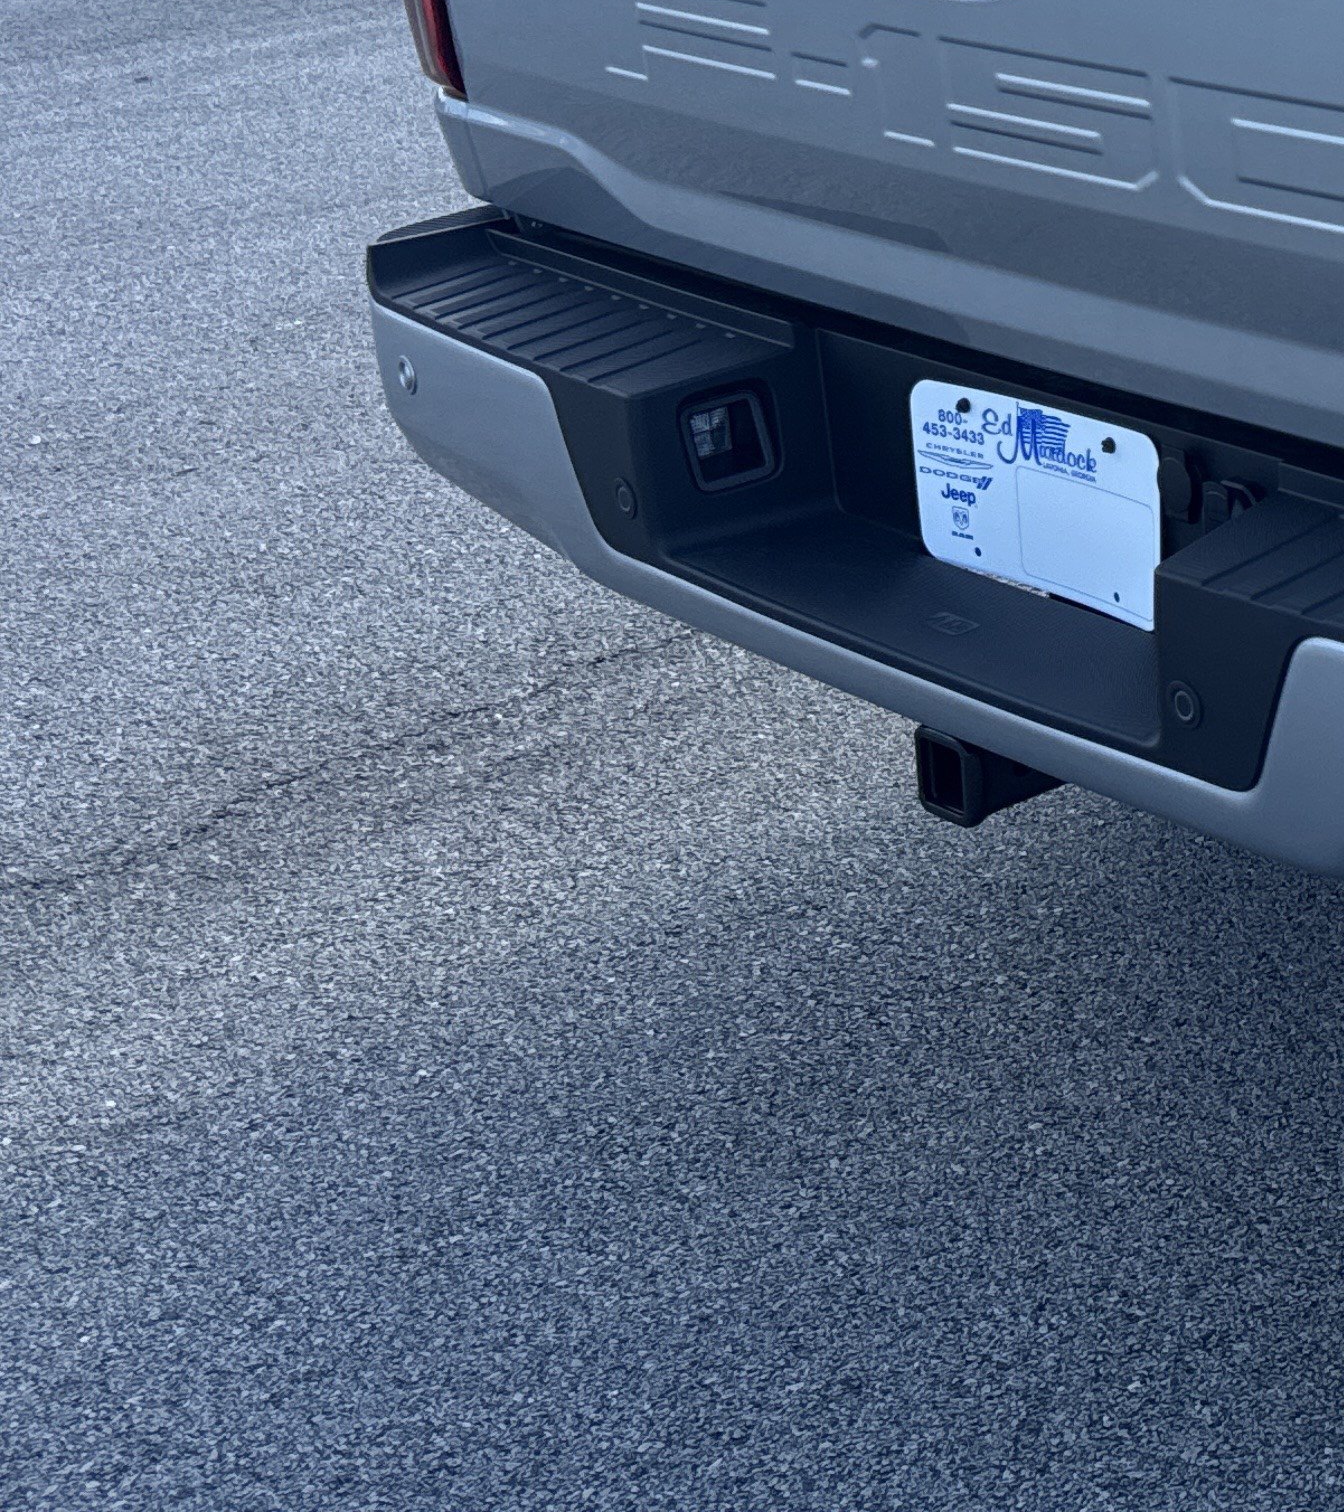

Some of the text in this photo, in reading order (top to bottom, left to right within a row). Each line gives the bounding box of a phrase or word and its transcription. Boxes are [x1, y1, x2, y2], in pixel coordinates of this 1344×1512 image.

[922, 423, 985, 446] 453-3433
[981, 407, 1098, 474] Ed Murdock
[925, 442, 984, 460] CHRYSLER
[919, 465, 981, 486] DODGE
[941, 483, 977, 507] Jeep
